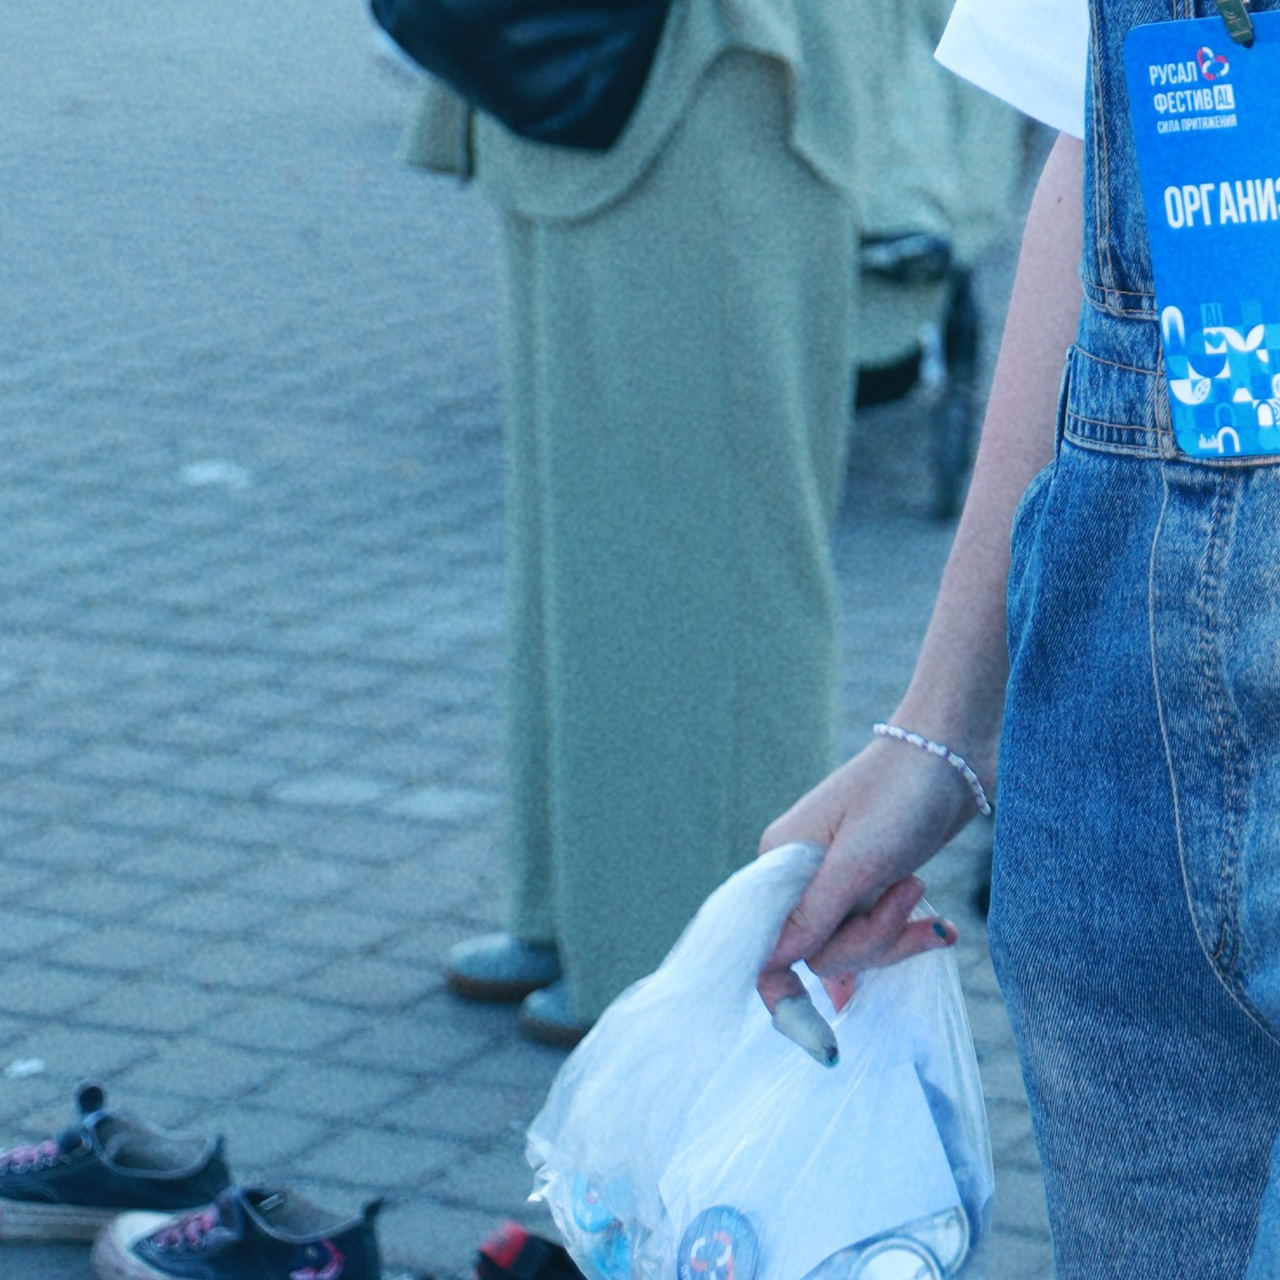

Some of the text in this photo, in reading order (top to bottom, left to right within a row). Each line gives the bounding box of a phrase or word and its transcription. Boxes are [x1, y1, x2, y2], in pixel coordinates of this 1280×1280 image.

[1149, 61, 1198, 86] РУСАЛ
[1157, 113, 1238, 134] СИЛА ПРИТЯЖЕНИЯ
